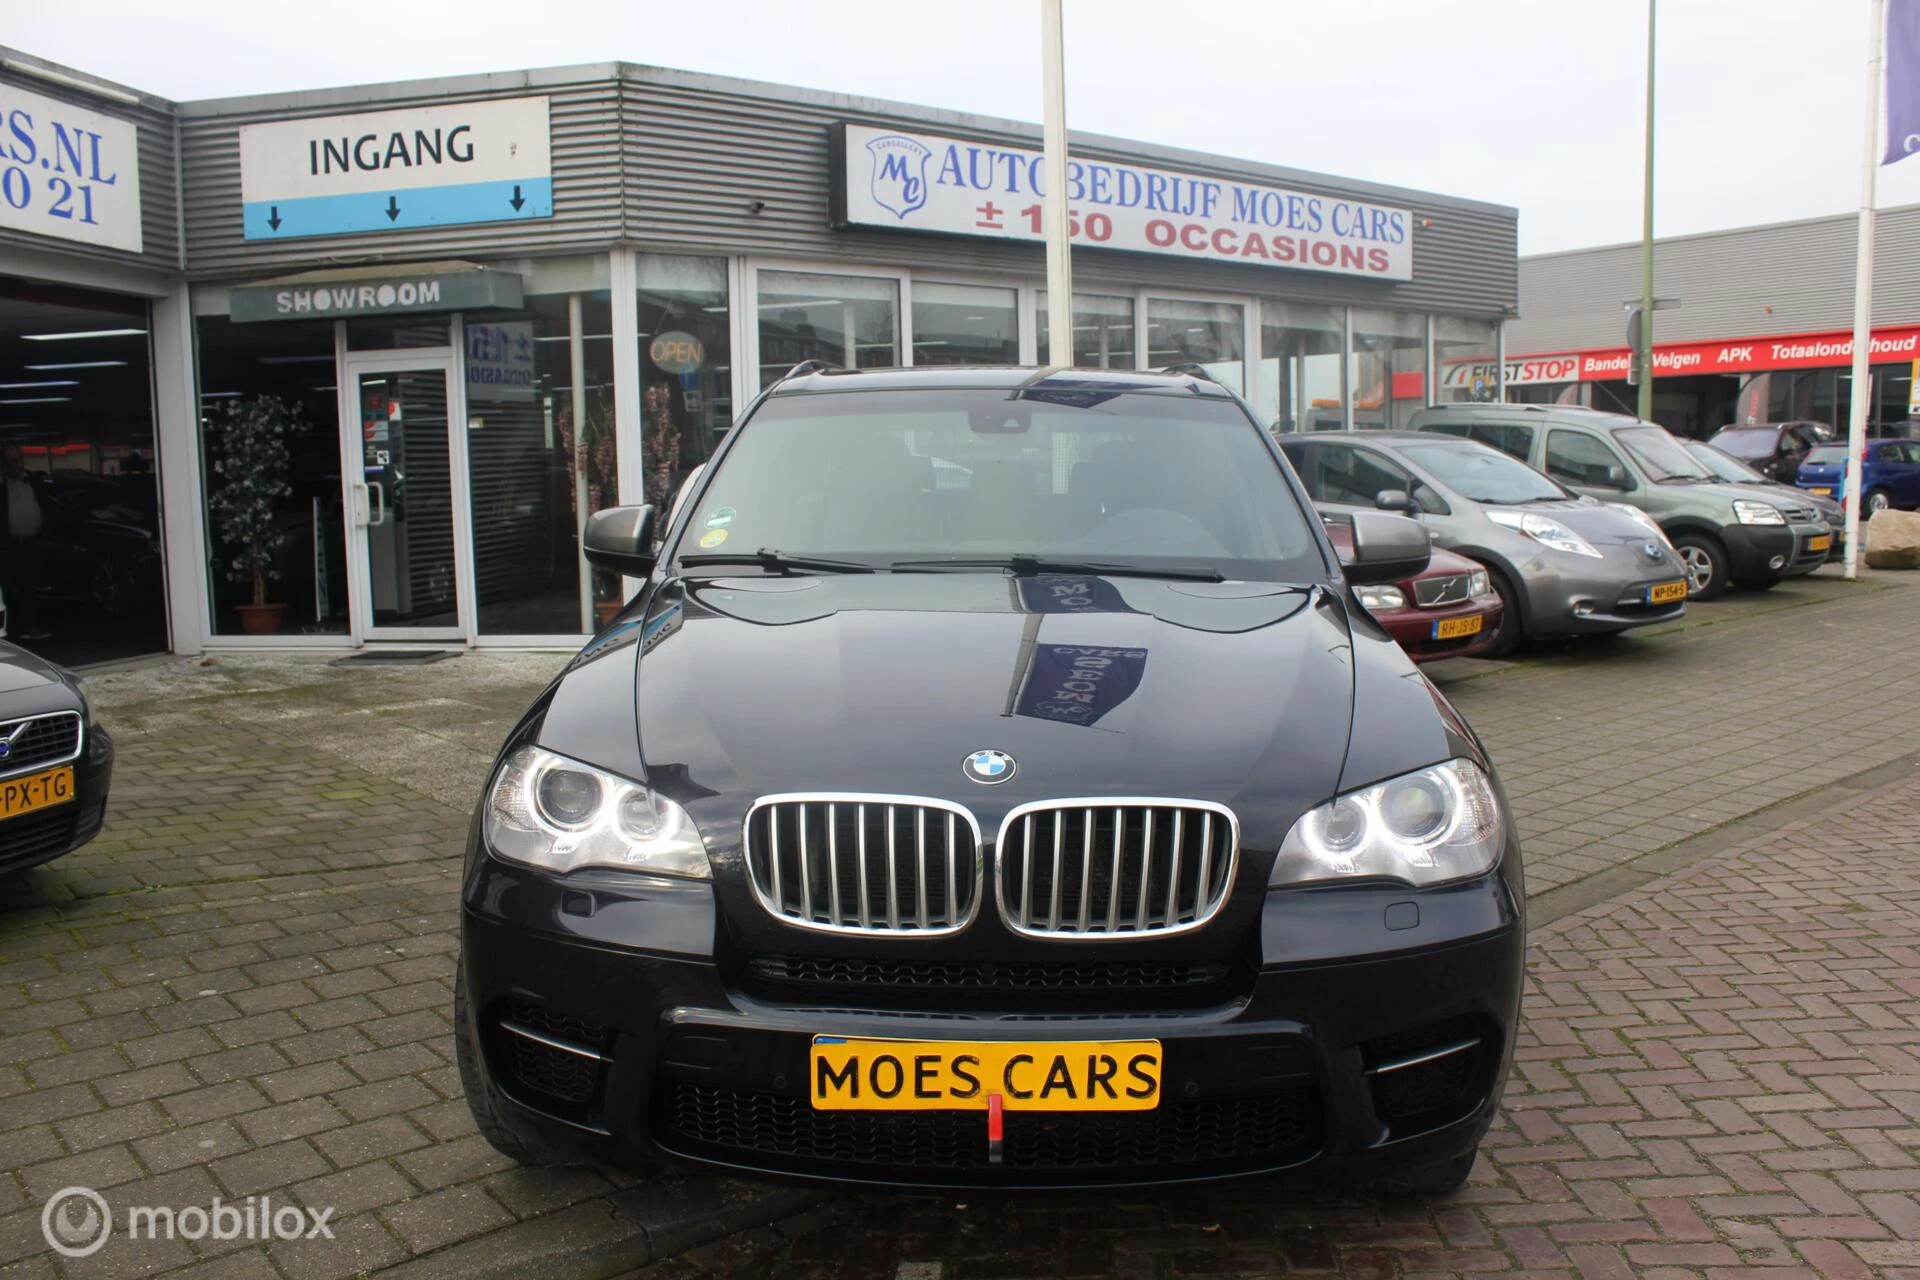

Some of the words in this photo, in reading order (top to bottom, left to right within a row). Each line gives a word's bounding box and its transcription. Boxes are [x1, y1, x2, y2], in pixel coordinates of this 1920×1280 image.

[0, 110, 117, 186] S.NL
[309, 125, 475, 176] INGANG
[48, 177, 99, 226] 21
[1231, 186, 1323, 233] MOES
[1332, 203, 1405, 245] CARS
[1145, 219, 1390, 273] OCCASIONS
[276, 281, 441, 314] SHOWROOM
[649, 341, 702, 365] OPEN
[1584, 356, 1630, 372] Bande
[1652, 351, 1701, 370] Velgen
[1717, 346, 1753, 363] APK
[1771, 335, 1918, 360] Totaalondhoud
[0, 773, 66, 812] PX-TG
[817, 1055, 981, 1099] MOES
[1003, 1054, 1158, 1099] CARS
